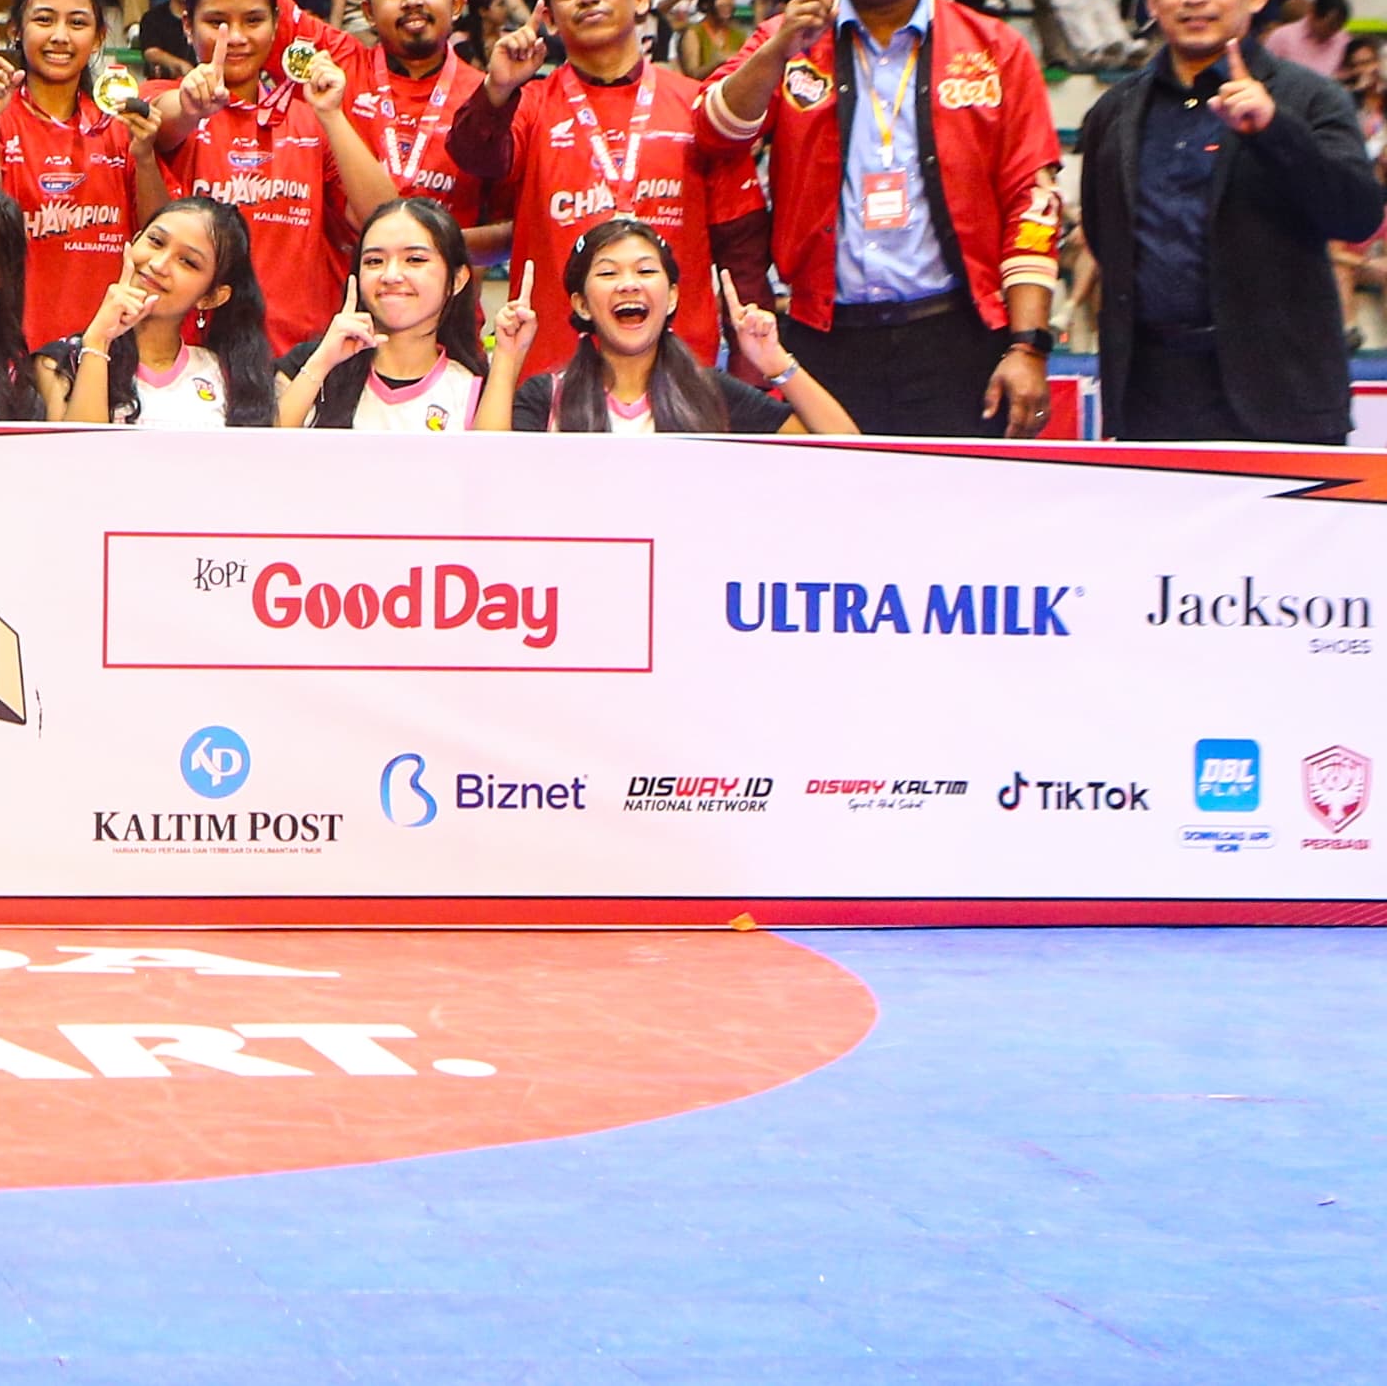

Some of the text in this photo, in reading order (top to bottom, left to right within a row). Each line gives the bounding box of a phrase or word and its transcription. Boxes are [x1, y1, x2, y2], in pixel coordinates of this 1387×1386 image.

[413, 170, 456, 191] PION
[549, 178, 683, 227] CHAPION
[23, 199, 120, 239] HAMPION
[434, 564, 558, 649] Day
[726, 582, 1070, 636] ULTRA MILK
[1147, 576, 1369, 628] Jackson
[1200, 757, 1256, 784] DBL
[457, 774, 583, 809] Biznet
[806, 780, 968, 794] DISWAY KALTIM
[1036, 782, 1148, 810] TikTok
[624, 800, 767, 811] NATIONAL NETWORK
[94, 812, 343, 841] KALTIM POST
